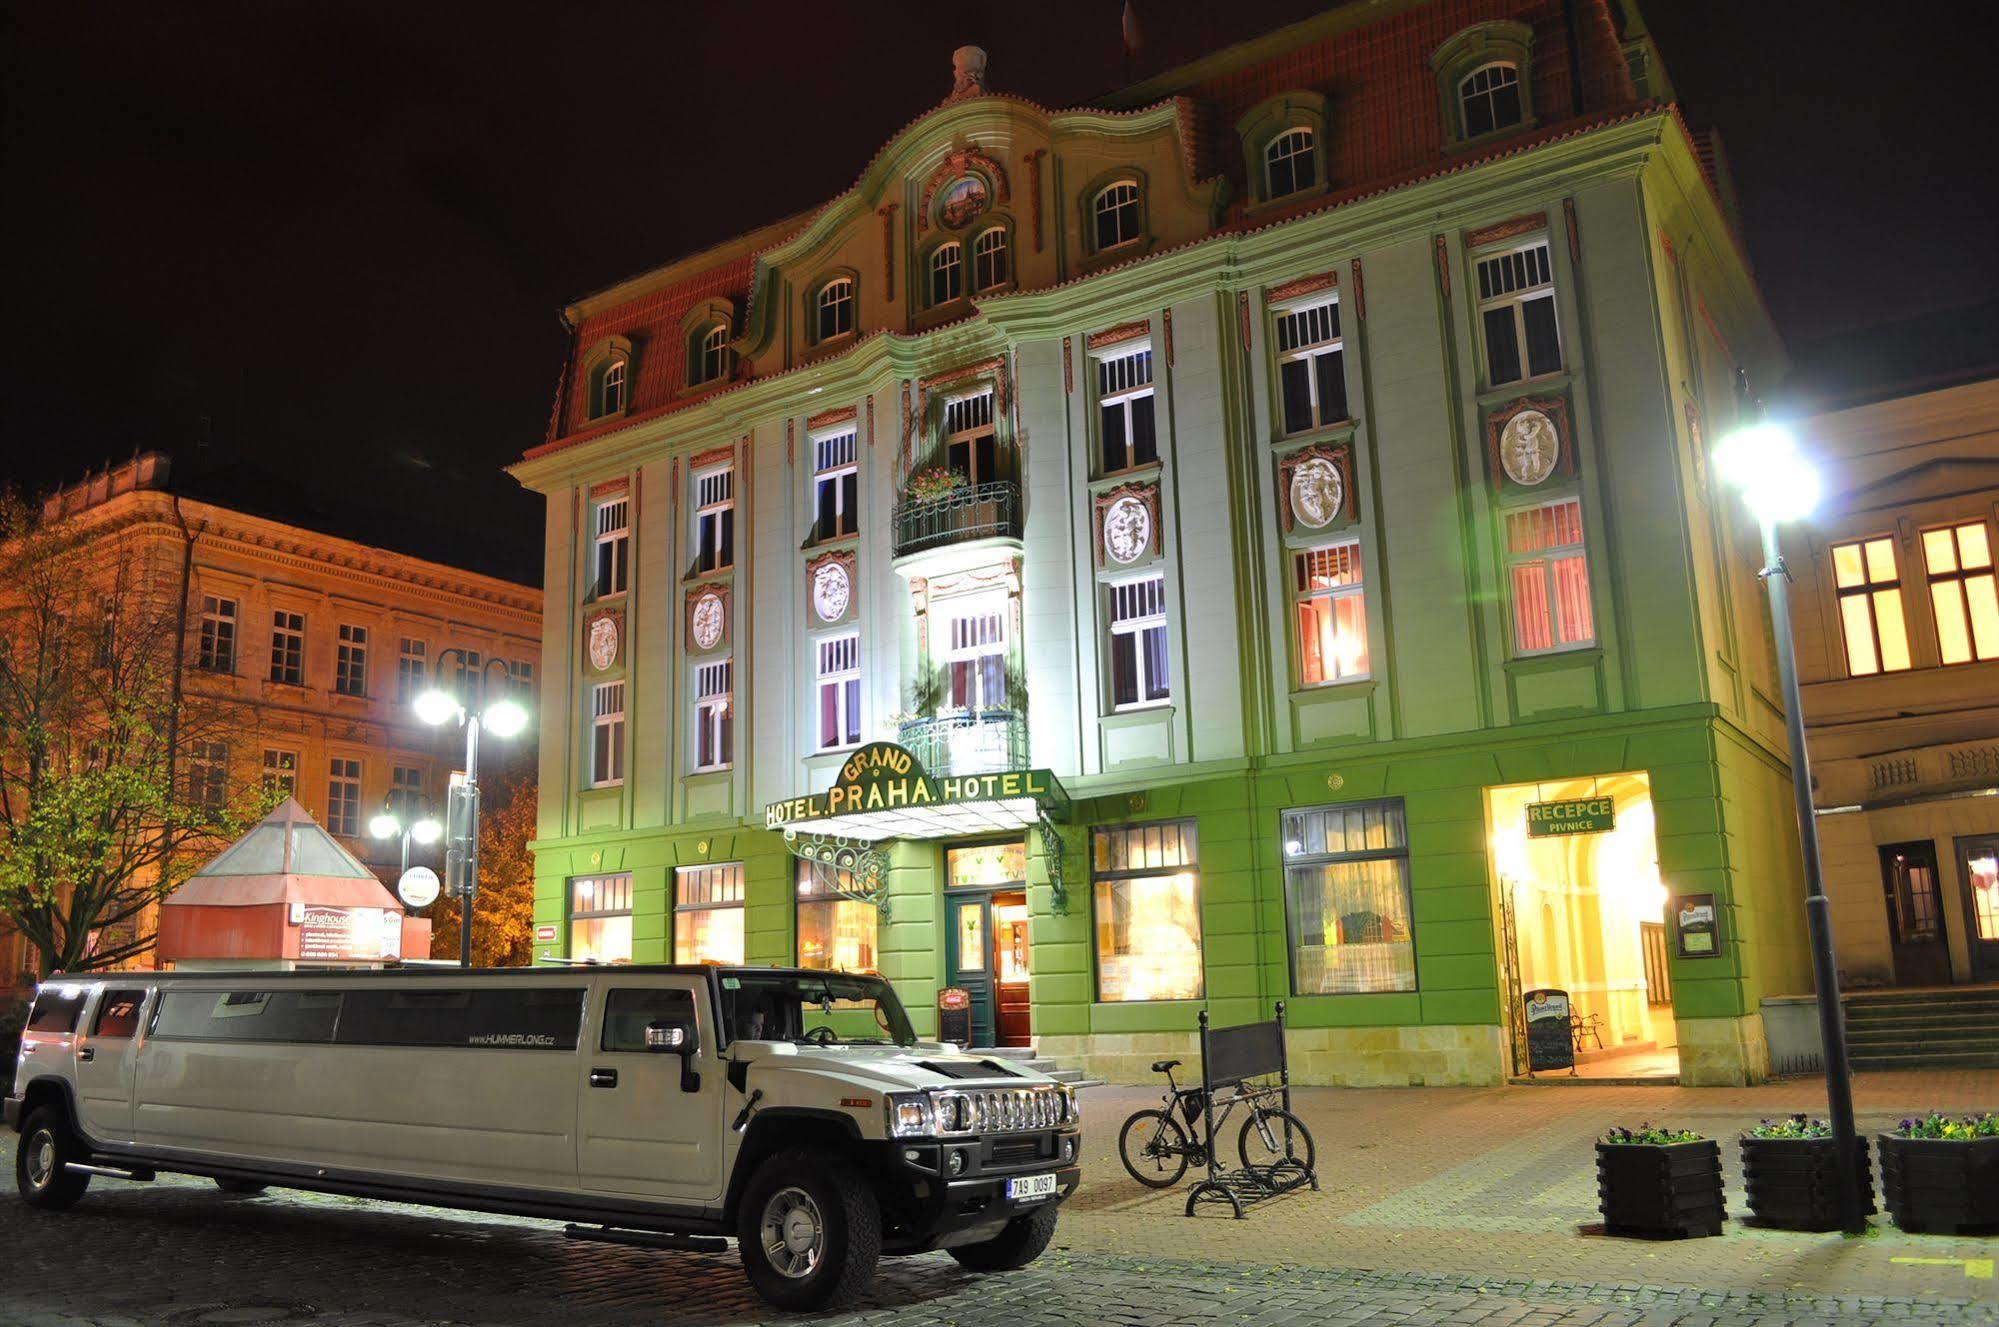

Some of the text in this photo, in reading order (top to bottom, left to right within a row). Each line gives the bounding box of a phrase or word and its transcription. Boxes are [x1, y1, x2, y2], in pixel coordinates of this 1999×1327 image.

[844, 746, 912, 781] GRAND
[766, 798, 820, 826] HOTEL
[944, 773, 1044, 800] HOTEL
[1530, 801, 1610, 820] RECEPCE
[1549, 820, 1593, 832] PIVNICE
[1013, 1179, 1029, 1195] 7A9
[1034, 1176, 1053, 1192] 0097
